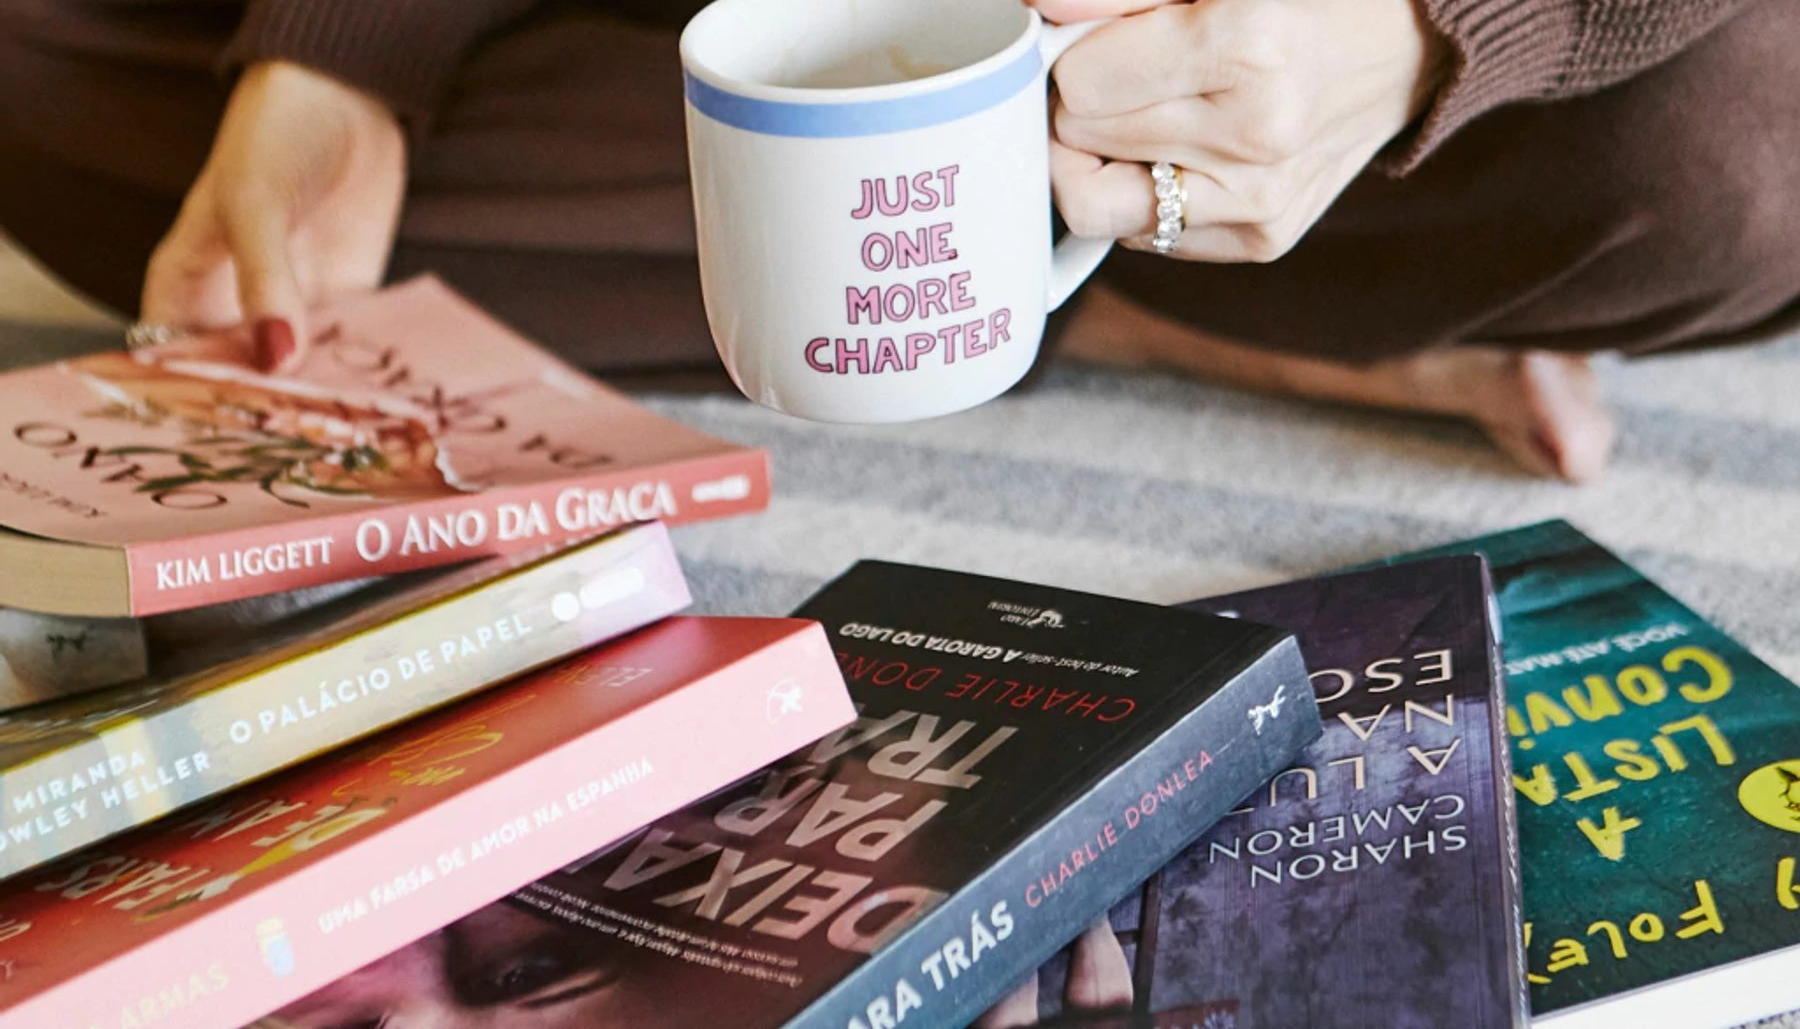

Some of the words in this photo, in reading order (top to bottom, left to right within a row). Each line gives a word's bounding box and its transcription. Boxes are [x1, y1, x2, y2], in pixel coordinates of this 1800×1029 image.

[851, 165, 959, 219] JUST
[861, 222, 958, 271] ONE
[846, 271, 976, 325] MORE
[805, 308, 1012, 375] CHAPTER
[155, 556, 211, 591] KIM
[218, 535, 335, 581] LIGGETT
[355, 518, 392, 563] O
[397, 509, 490, 556] ANO
[497, 500, 550, 541] DA
[838, 621, 889, 643] LAGO
[891, 630, 926, 648] DO
[924, 636, 1003, 660] GAROTA
[1001, 648, 1024, 664] A
[229, 721, 253, 745] O
[258, 666, 392, 734] PALÁCIO
[396, 649, 435, 681] DE
[439, 614, 533, 665] PAPEL
[945, 673, 1137, 722] CHARLIE
[1337, 693, 1455, 742] NA
[12, 751, 147, 814] MIRANDA
[100, 750, 211, 810] HELLER
[1229, 756, 1367, 815] LU
[1406, 738, 1462, 775] A
[1511, 713, 1737, 807] LISTA
[317, 898, 368, 934] UMA
[368, 863, 438, 911] FARSA
[437, 847, 467, 876] DE
[470, 815, 531, 861] AMOR
[534, 802, 565, 829] NA
[566, 756, 657, 813] ESPANHA
[1209, 794, 1466, 864] CAMERON
[1250, 825, 1467, 889] SHARON
[1576, 805, 1643, 861] A
[34, 853, 212, 911] FARS
[580, 825, 951, 953] DEIXA
[920, 899, 1016, 992] TRÁS
[1024, 822, 1120, 910] CHARLIE
[1124, 750, 1216, 830] DONLEA
